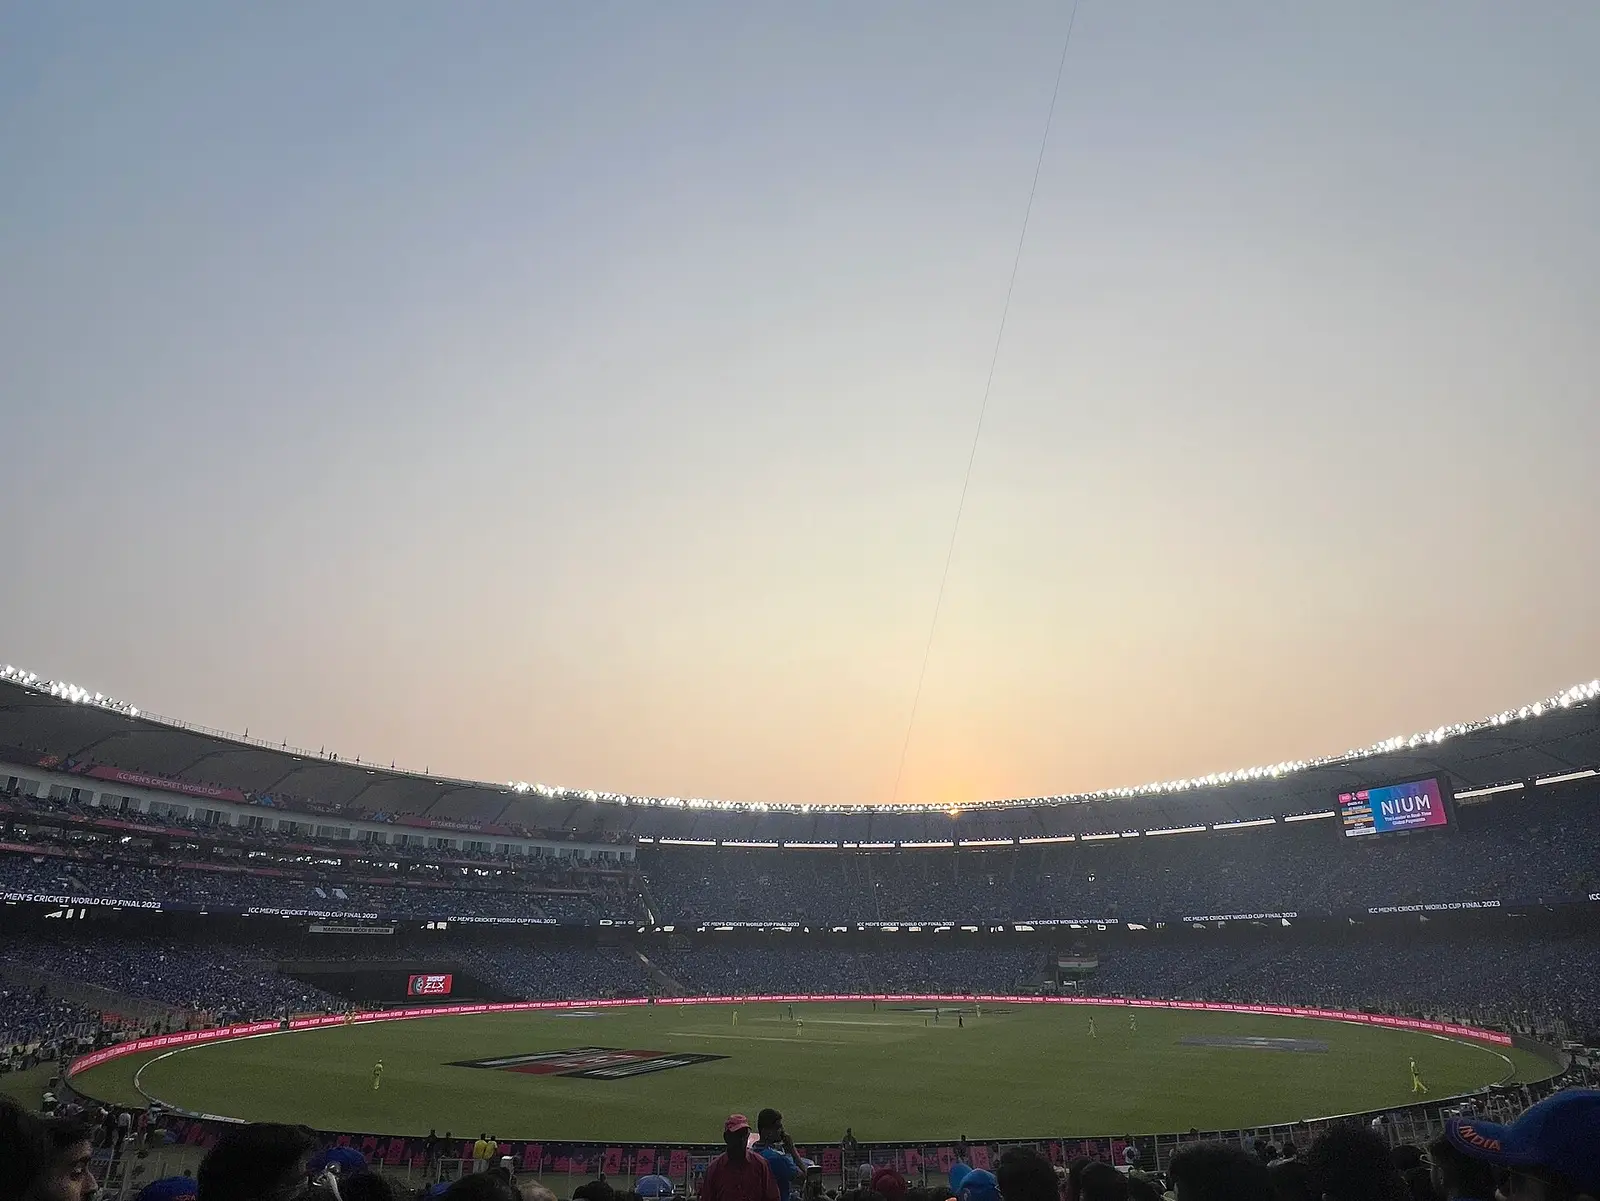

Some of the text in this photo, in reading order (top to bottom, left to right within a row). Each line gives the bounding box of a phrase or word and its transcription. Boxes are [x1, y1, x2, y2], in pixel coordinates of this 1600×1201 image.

[116, 772, 129, 780] ICC
[130, 774, 150, 785] MEN'S
[152, 778, 180, 789] CRICKET
[183, 784, 207, 793] WORLD
[1381, 795, 1431, 815] NIUM
[4, 892, 32, 901] MEN'S
[33, 894, 70, 904] CRICKET
[71, 896, 99, 905] WORLD
[100, 898, 116, 906] CUP
[117, 900, 140, 908] FINAL
[142, 901, 160, 909] 2023
[1459, 1125, 1500, 1152] INDIA
